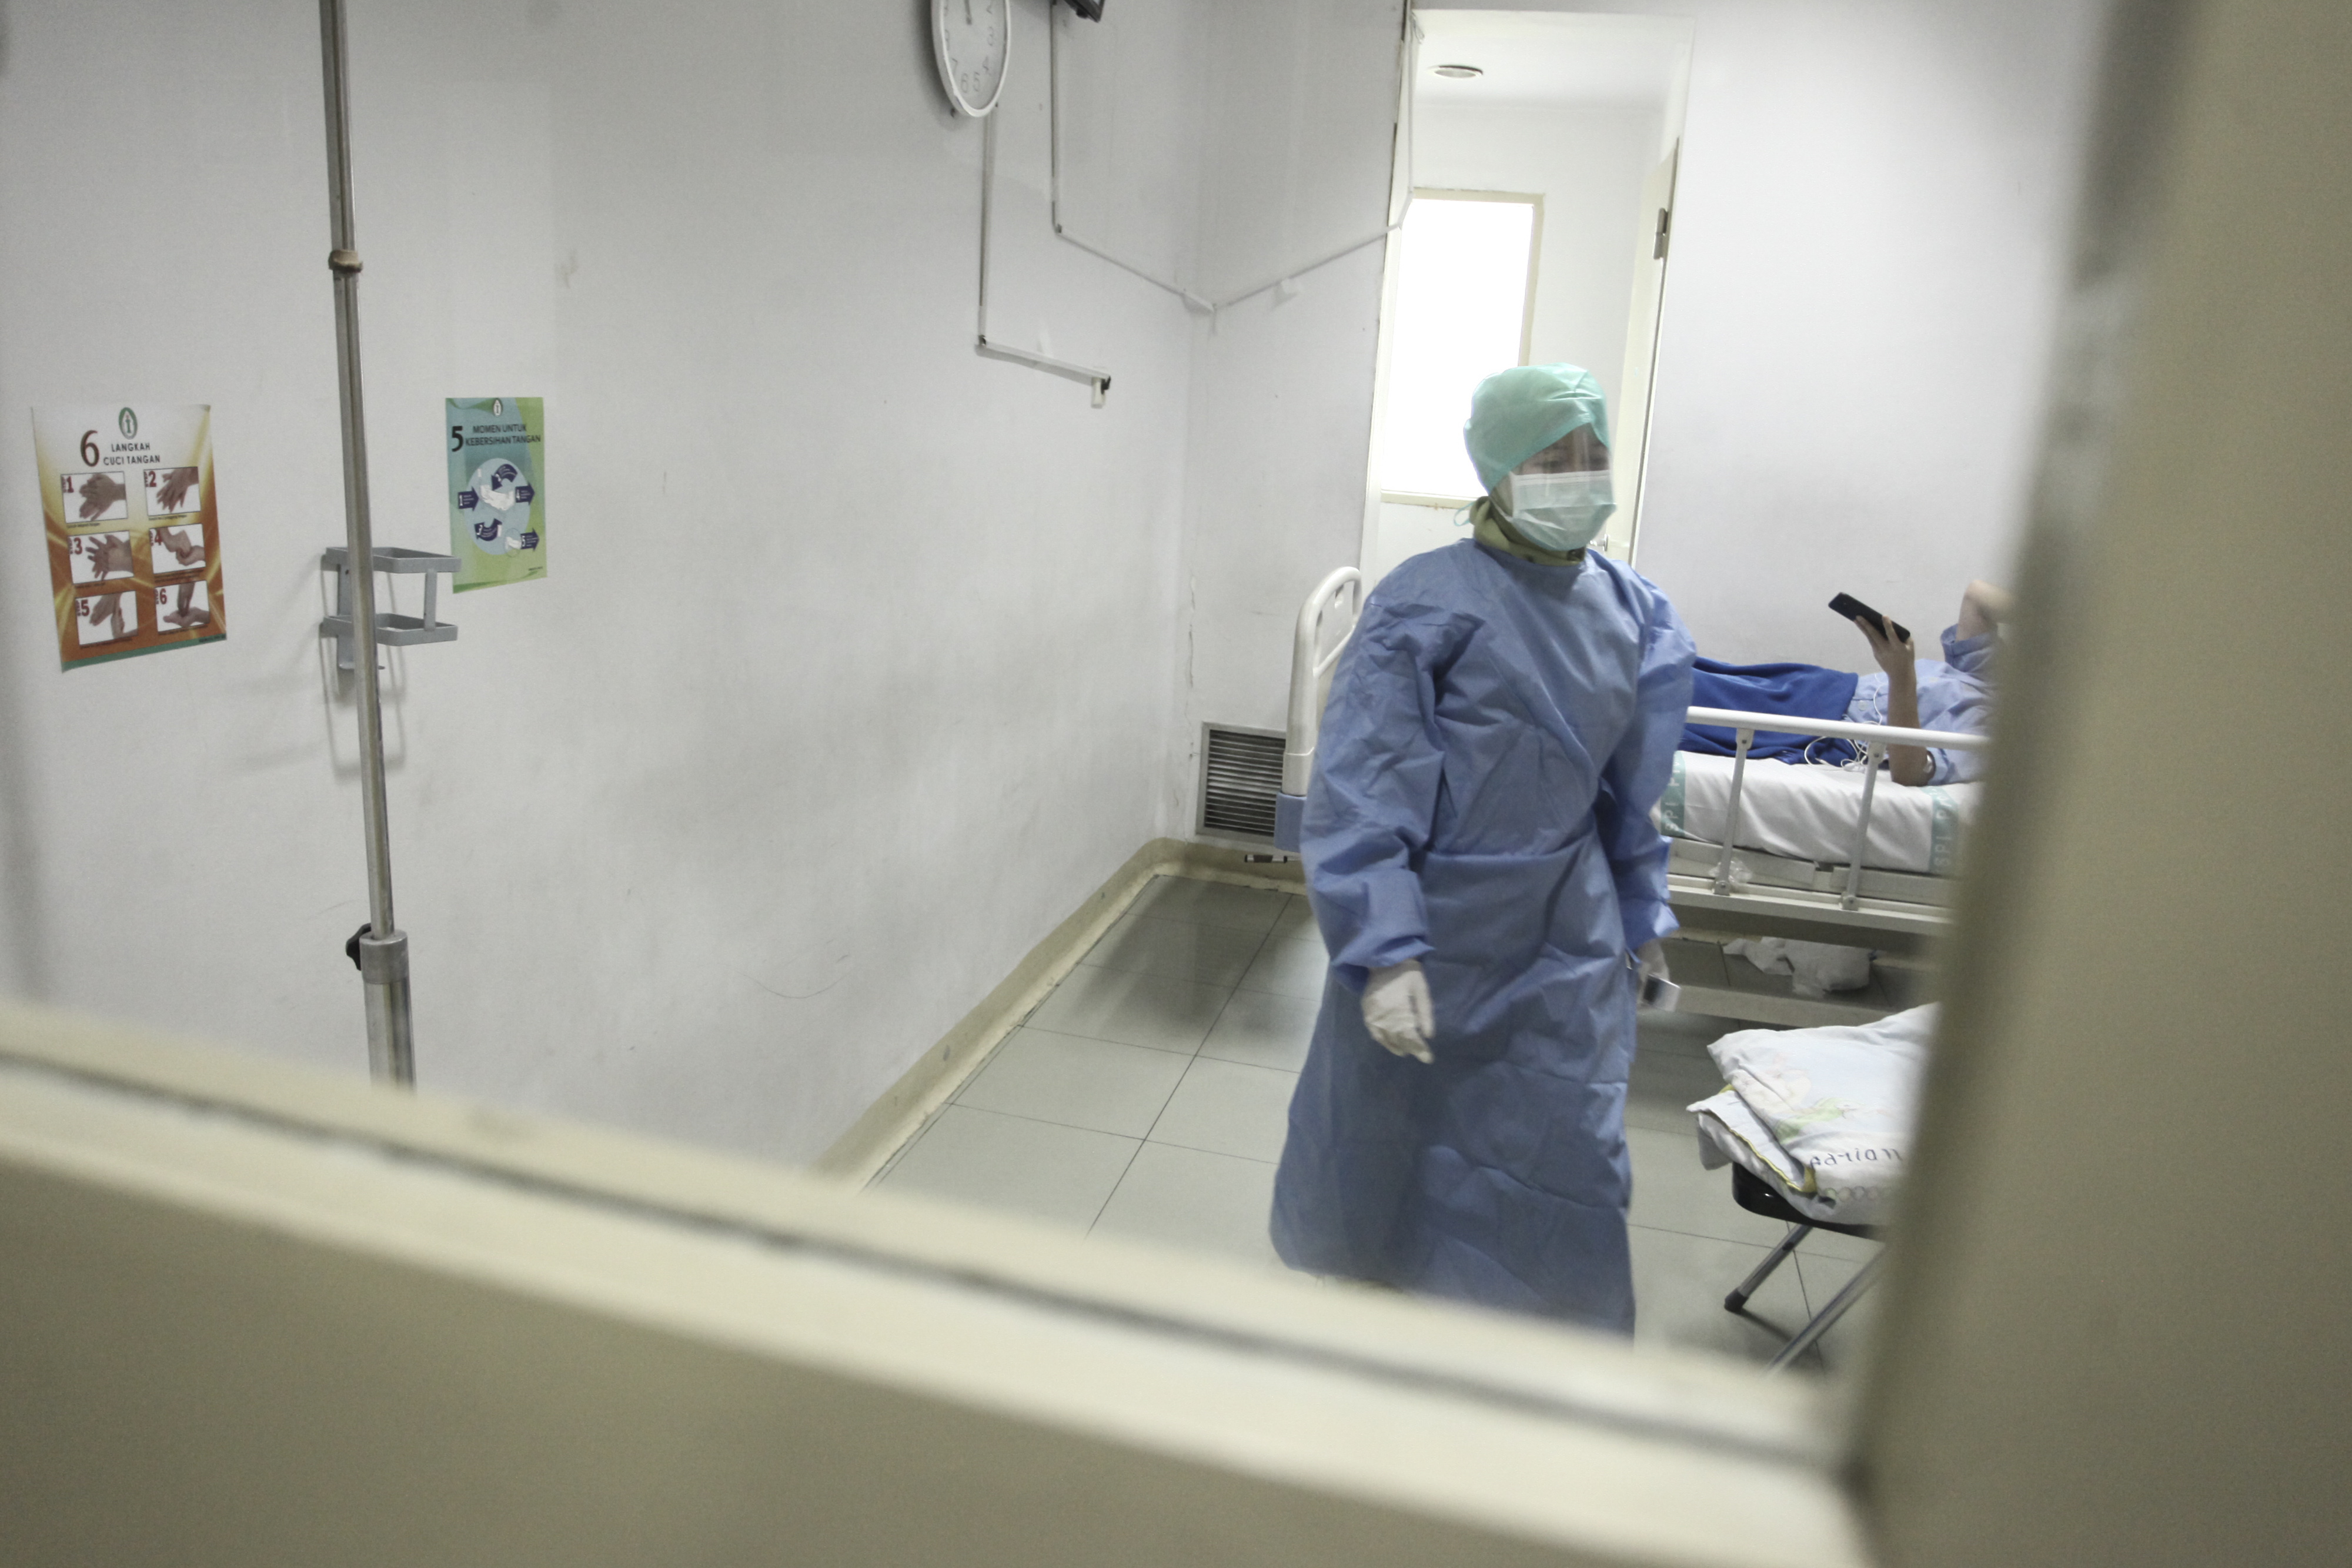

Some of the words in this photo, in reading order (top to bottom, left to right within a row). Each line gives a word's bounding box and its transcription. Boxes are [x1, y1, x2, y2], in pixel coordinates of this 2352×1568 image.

[960, 72, 968, 93] 6
[973, 71, 981, 92] 5
[473, 424, 501, 434] MOMEN
[502, 423, 527, 433] UNTUK
[111, 442, 151, 453] LANGKAH
[451, 425, 464, 453] 5
[465, 436, 512, 446] KEBERSIHAN
[512, 434, 541, 444] TANGAN
[80, 429, 100, 467] 6
[103, 456, 125, 466] CUCI
[126, 454, 161, 464] TANGAN
[66, 476, 74, 493] 1
[148, 470, 156, 487] 2
[74, 537, 83, 555] 3
[159, 588, 168, 605] 6
[81, 599, 90, 617] 5
